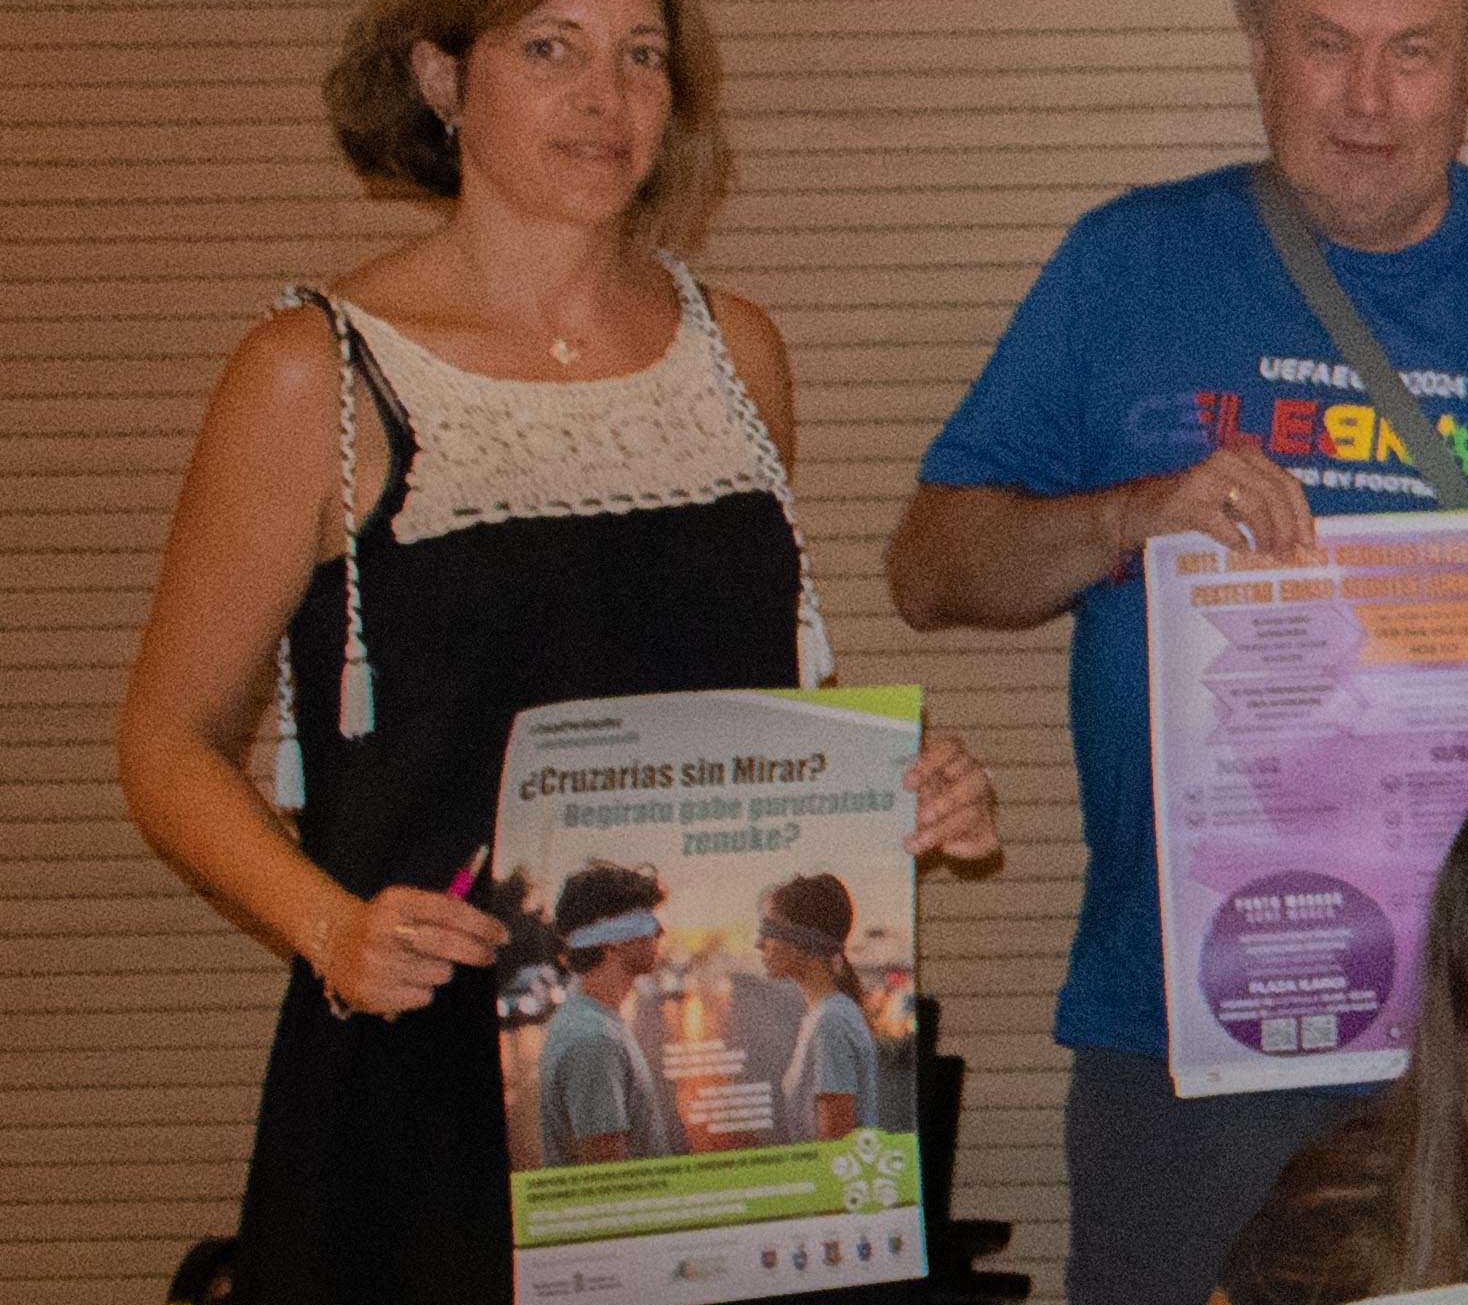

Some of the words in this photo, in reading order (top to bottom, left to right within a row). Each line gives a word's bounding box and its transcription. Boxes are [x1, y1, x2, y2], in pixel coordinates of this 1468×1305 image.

[680, 758, 724, 787] sin
[732, 752, 827, 786] Mirar?
[678, 796, 742, 825] gabe
[682, 823, 800, 856] zenuke?
